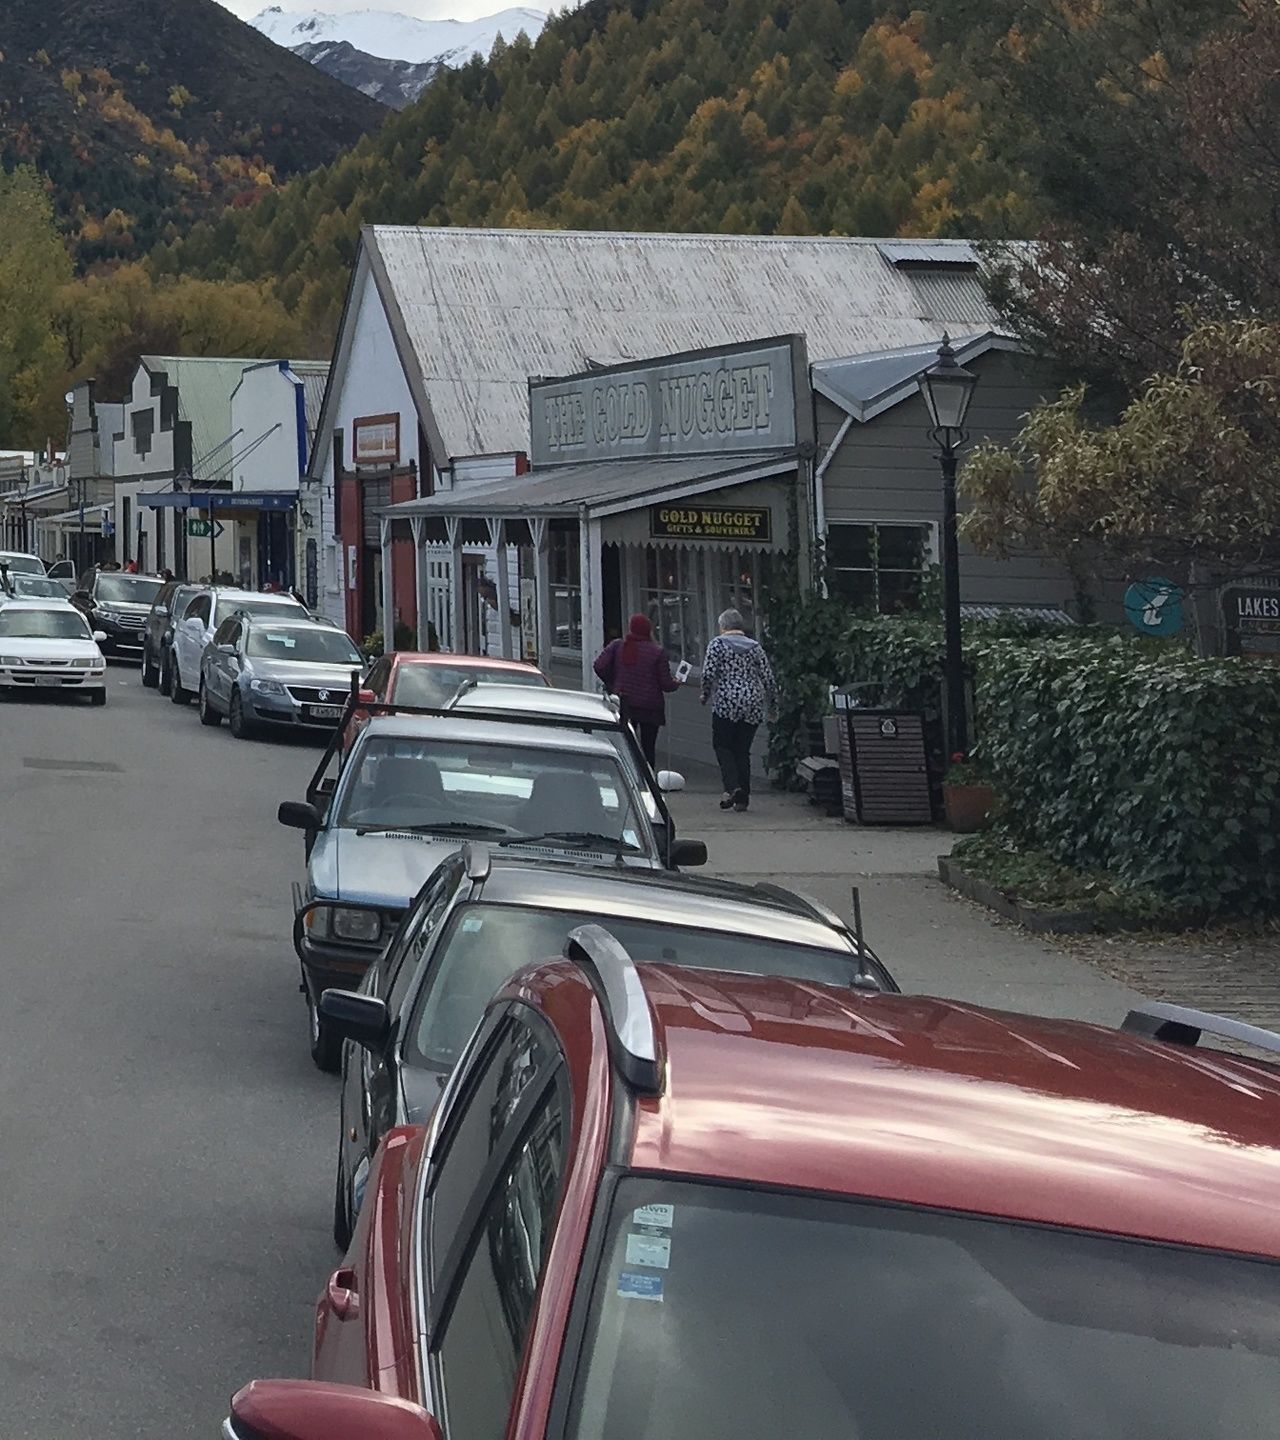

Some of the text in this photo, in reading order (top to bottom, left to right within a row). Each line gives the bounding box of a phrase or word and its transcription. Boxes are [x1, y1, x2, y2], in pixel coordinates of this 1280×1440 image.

[544, 362, 775, 451] THE GOLD NUGGET
[659, 510, 763, 527] GOLD NUGGET
[666, 523, 694, 534] GIFTS
[704, 525, 756, 536] SOUVENIRS
[1237, 597, 1279, 617] LAKES
